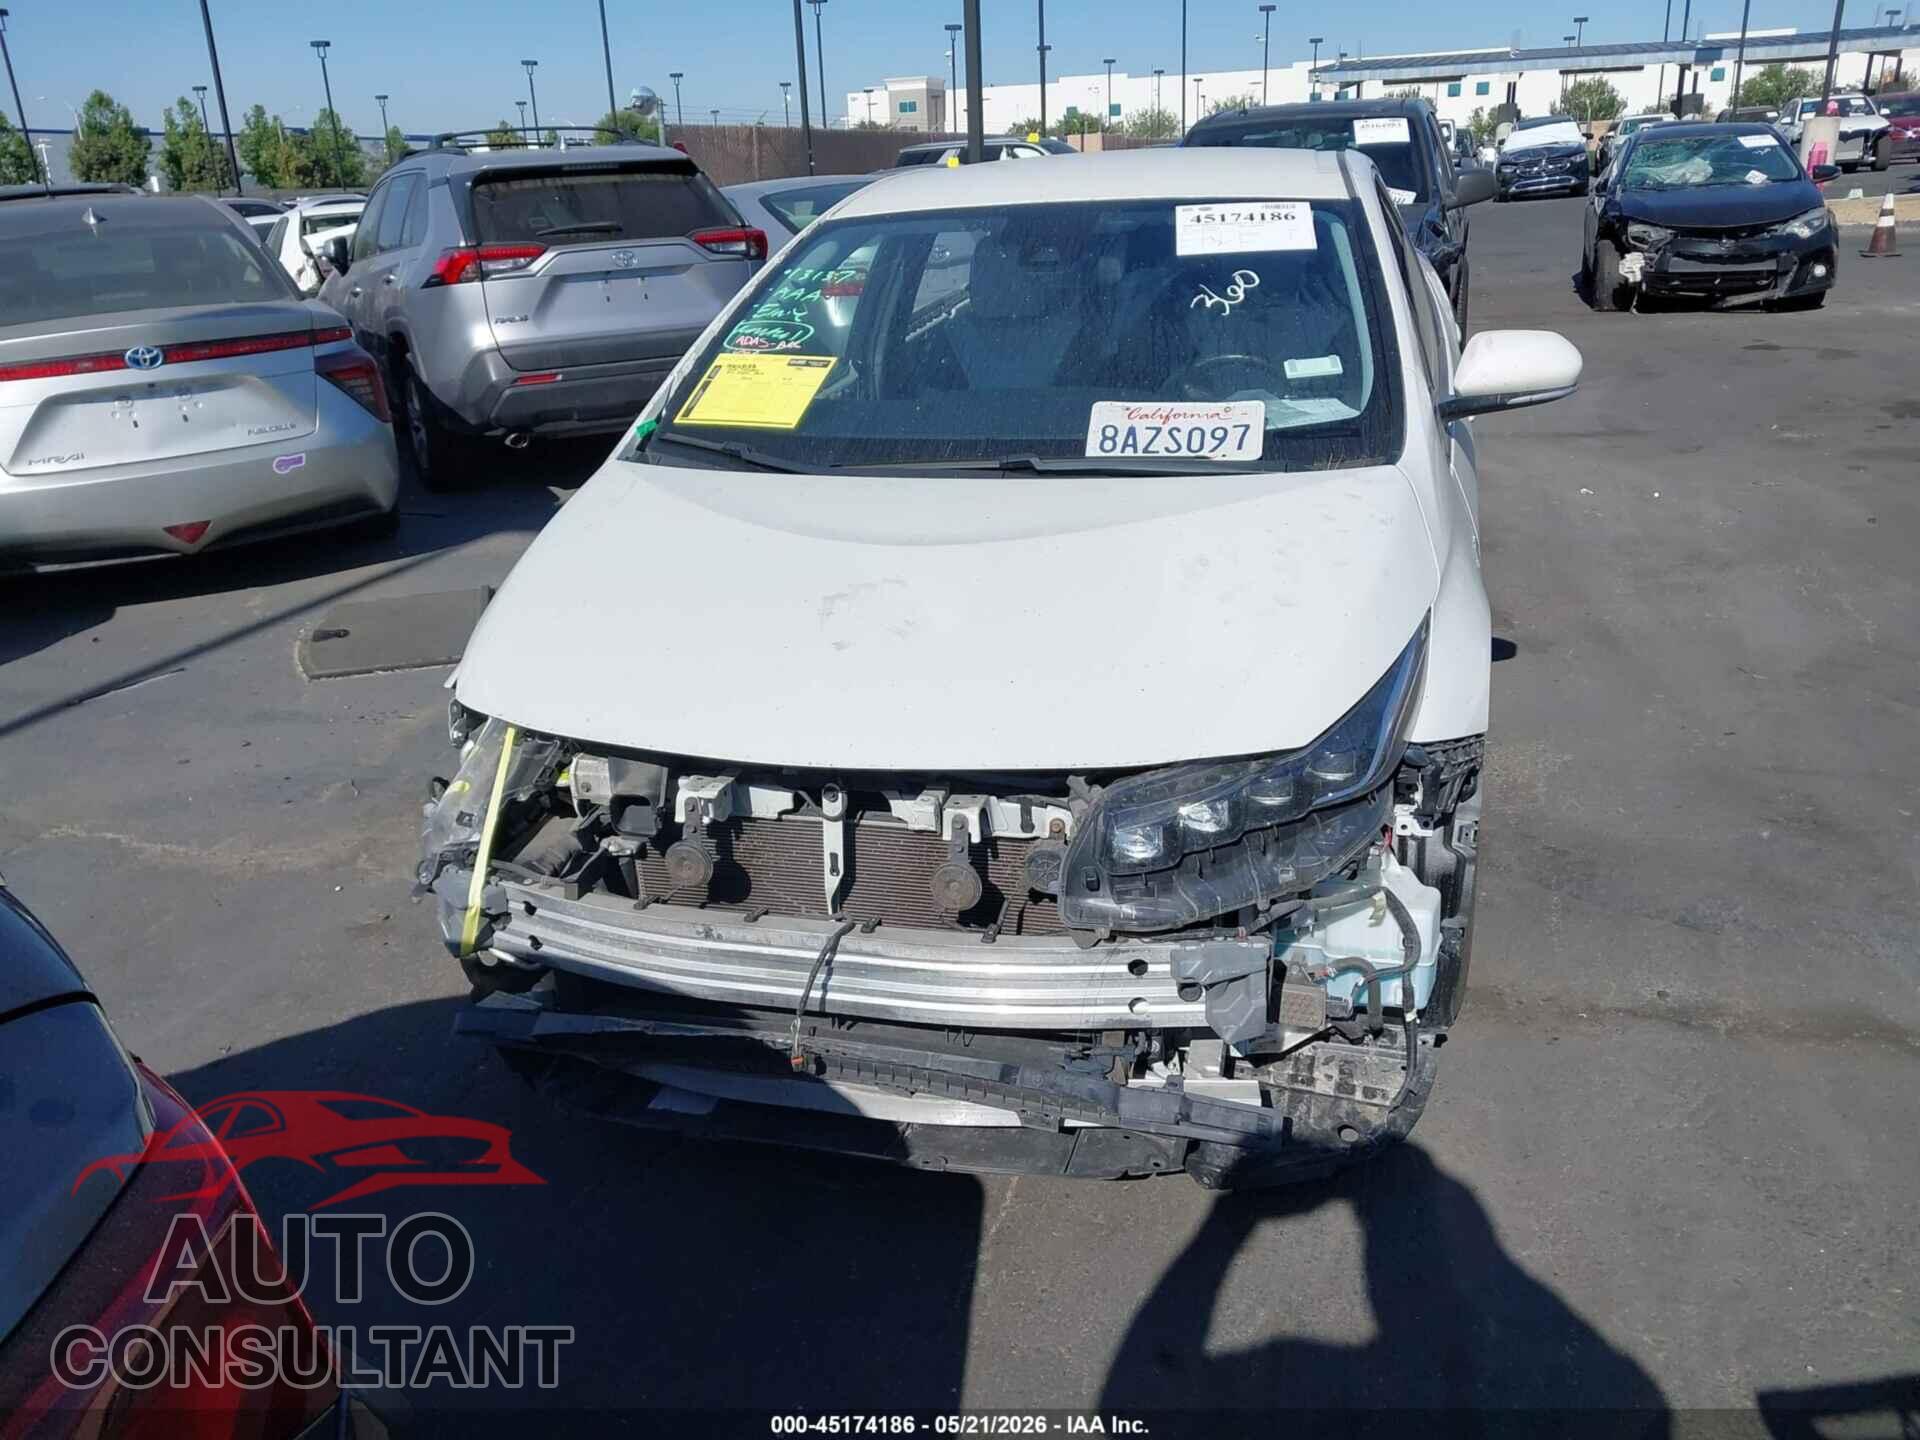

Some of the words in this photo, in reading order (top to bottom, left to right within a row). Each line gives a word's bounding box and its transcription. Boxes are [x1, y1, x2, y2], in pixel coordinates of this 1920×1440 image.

[1190, 210, 1297, 224] 45174186
[1127, 406, 1233, 425] California
[1098, 424, 1251, 455] 8AZS097
